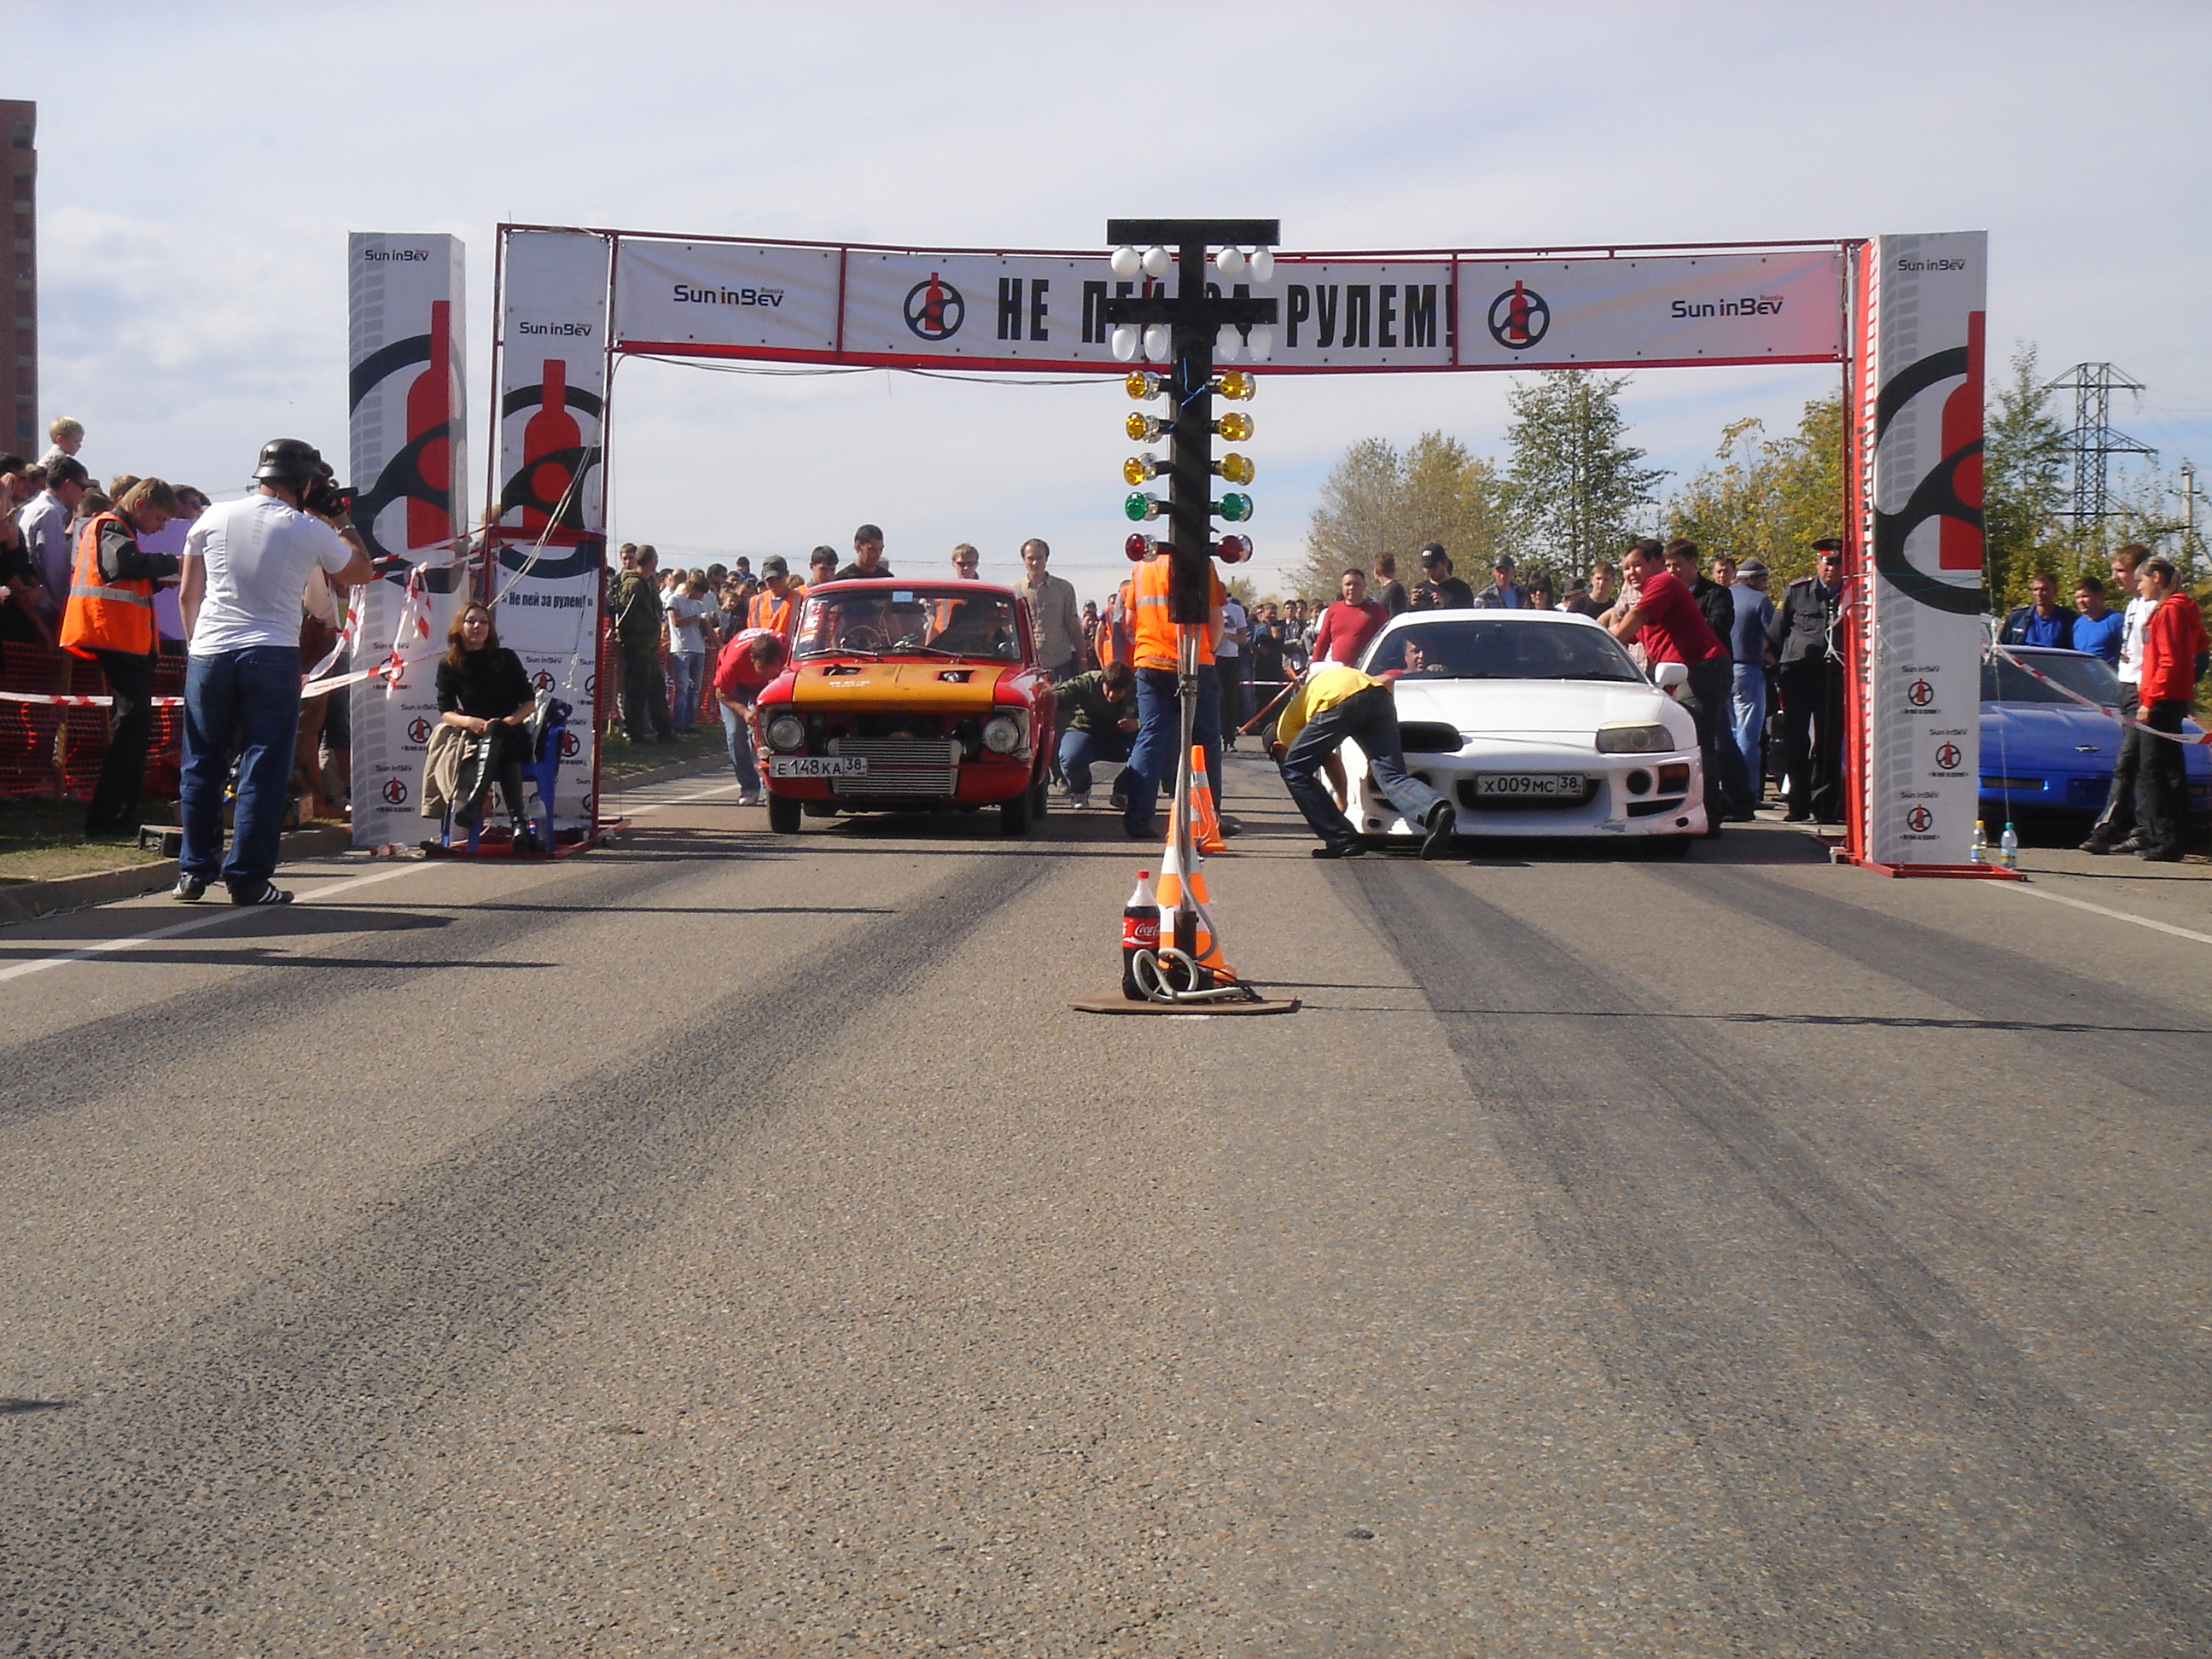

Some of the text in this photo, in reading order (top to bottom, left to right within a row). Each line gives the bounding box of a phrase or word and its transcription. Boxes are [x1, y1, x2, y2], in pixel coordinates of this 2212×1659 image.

[364, 249, 428, 262] Sun inBev
[1897, 259, 1965, 271] Sun inBev
[673, 284, 783, 307] Sun inBev
[997, 276, 1050, 342] НЕ
[1671, 298, 1783, 318] Sun inBev
[1286, 284, 1453, 348] РУЛЕМ!
[519, 322, 591, 337] Sun inBev
[846, 758, 862, 771] 38
[1560, 777, 1578, 789] 38
